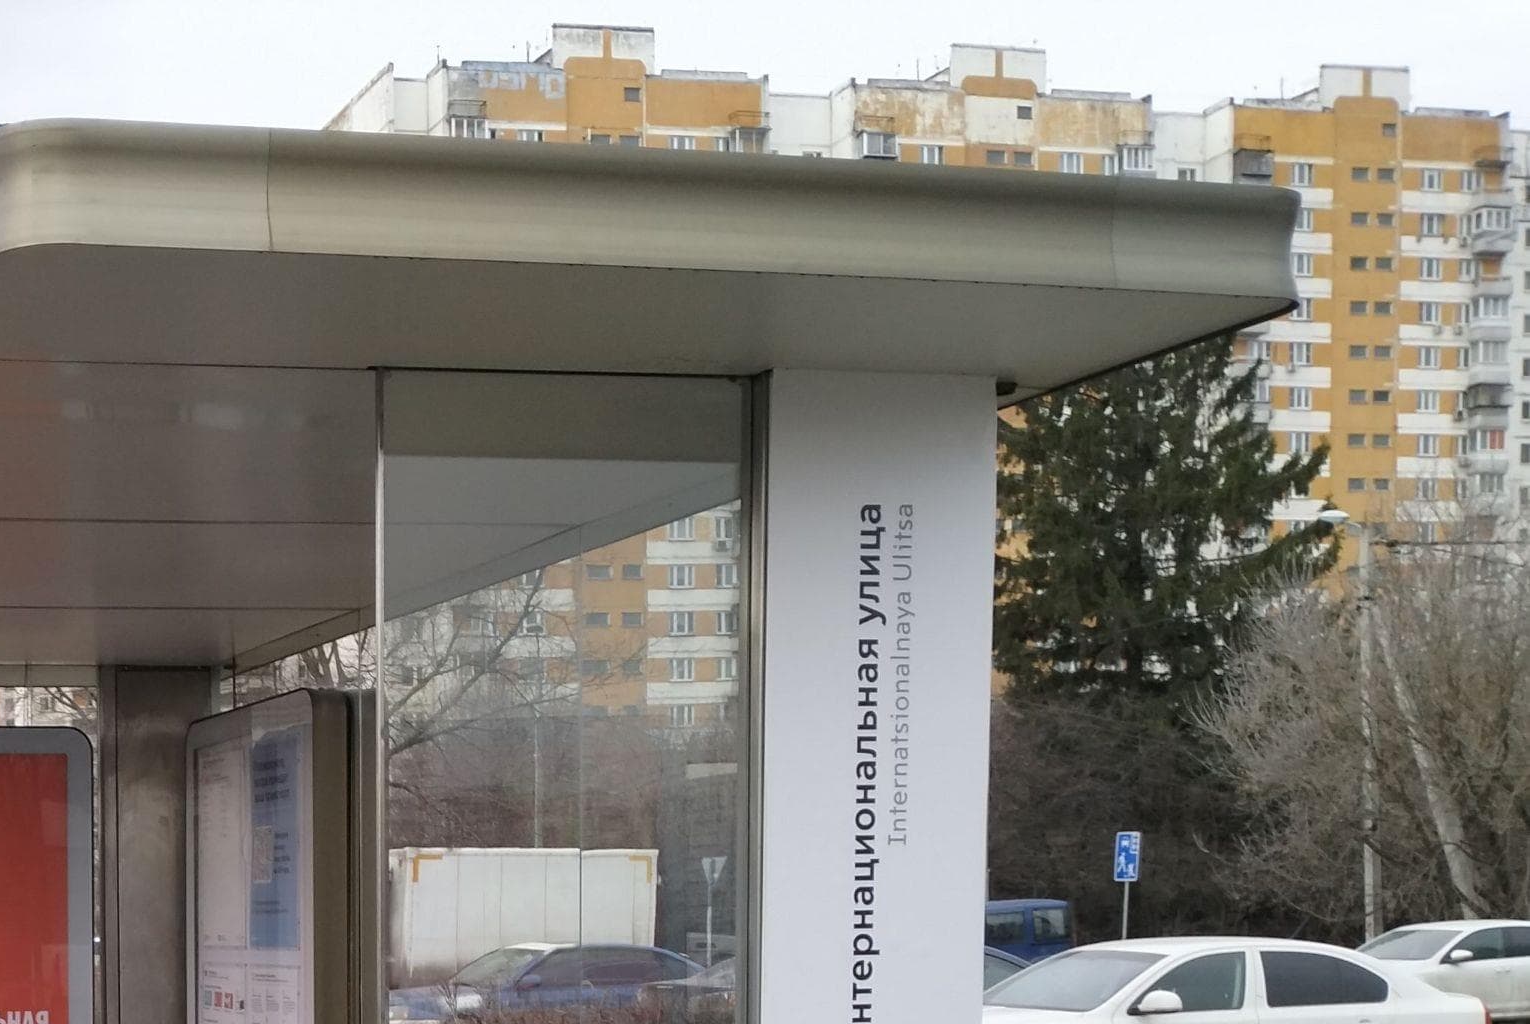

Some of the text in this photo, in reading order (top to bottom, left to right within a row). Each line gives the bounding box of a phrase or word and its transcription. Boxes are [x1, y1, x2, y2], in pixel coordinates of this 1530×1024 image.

[858, 503, 887, 627] улица
[887, 503, 916, 845] Internatsionalnaya Ulitsa
